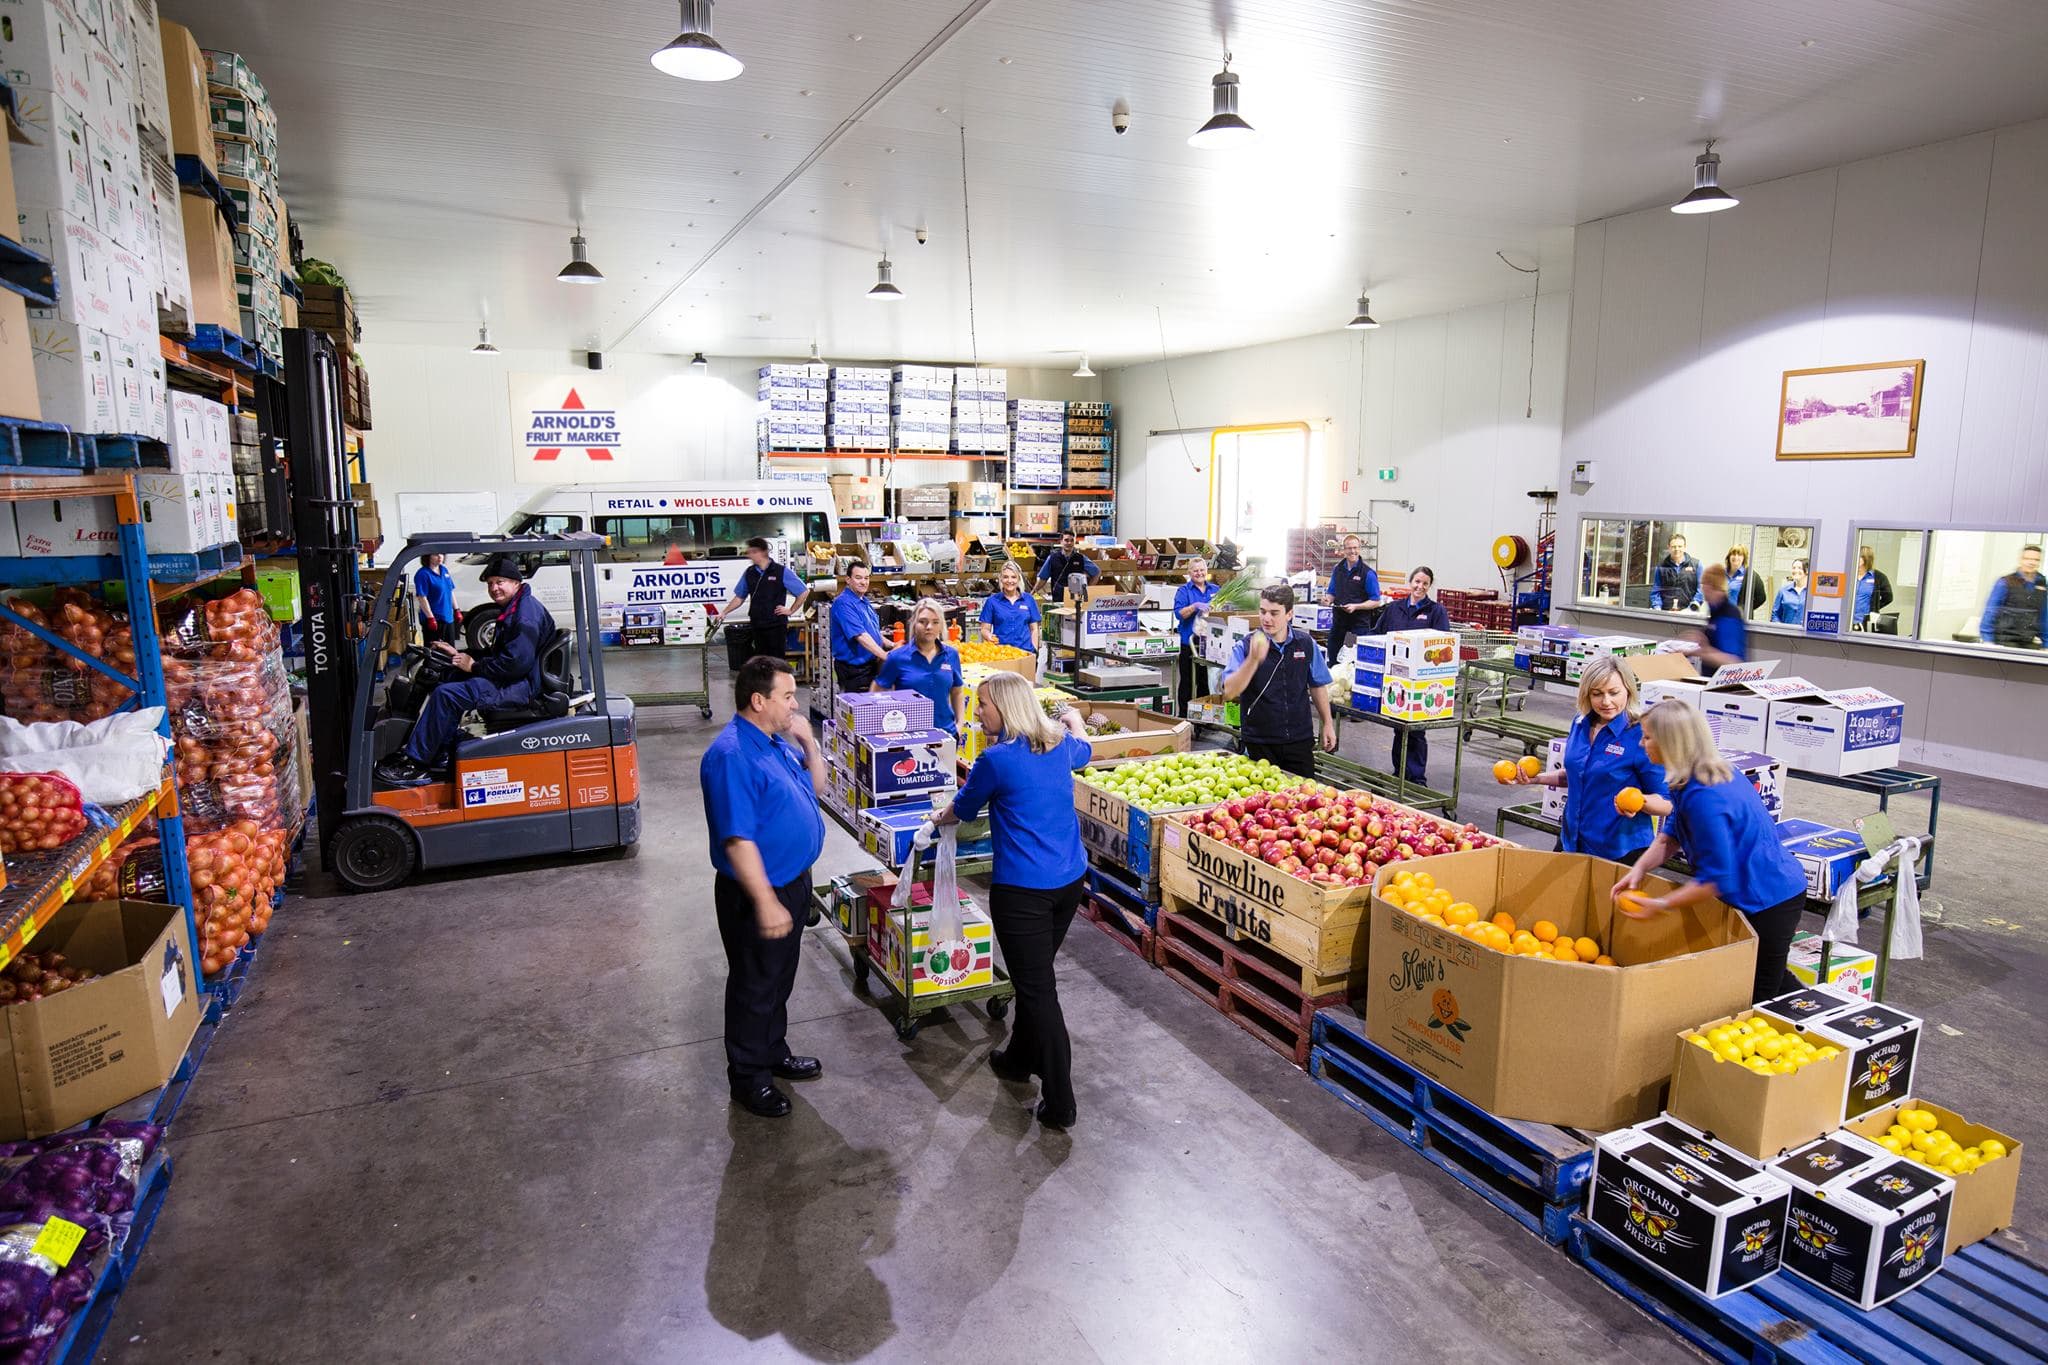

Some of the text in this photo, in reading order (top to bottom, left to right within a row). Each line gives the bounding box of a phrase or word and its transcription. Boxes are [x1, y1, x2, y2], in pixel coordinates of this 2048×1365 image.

[532, 416, 615, 429] ARNOLD'S
[526, 432, 620, 442] FRUIT MARKET
[608, 497, 813, 508] RETAIL WHOLESALE ONLINE
[25, 541, 52, 554] Large
[26, 533, 52, 547] Extra
[633, 572, 721, 587] ARNOLD'S
[627, 588, 726, 601] FRUIT MARKET
[1808, 620, 1838, 631] OPEN
[311, 612, 329, 674] TOYOTA
[1849, 713, 1879, 728] home
[541, 733, 591, 747] TOYOTA
[1849, 726, 1897, 743] delivery
[896, 775, 935, 785] TOMATOES
[486, 787, 522, 797] FORKLIFT
[528, 784, 561, 800] SAS
[578, 786, 609, 804] 15
[1186, 831, 1285, 909] Snowline
[1196, 879, 1271, 942] Fruits
[930, 969, 971, 987] capsicums
[1389, 947, 1445, 992] Mario's
[48, 1027, 98, 1052] MANUFACTURED
[1407, 1016, 1462, 1057] PACKHOUSE
[1866, 1043, 1901, 1064] ORCHARD
[1864, 1081, 1891, 1100] BREEZE
[1622, 1176, 1680, 1218] ORCHARD
[1741, 1218, 1771, 1237] ORCHARD
[1791, 1206, 1839, 1236] ORCHARD
[1899, 1211, 1937, 1239] ORCHARD
[1623, 1218, 1668, 1255] BREEZE
[1741, 1250, 1764, 1263] BREEZE
[1792, 1236, 1829, 1261] BREEZE
[1897, 1256, 1927, 1280] BREEZE
